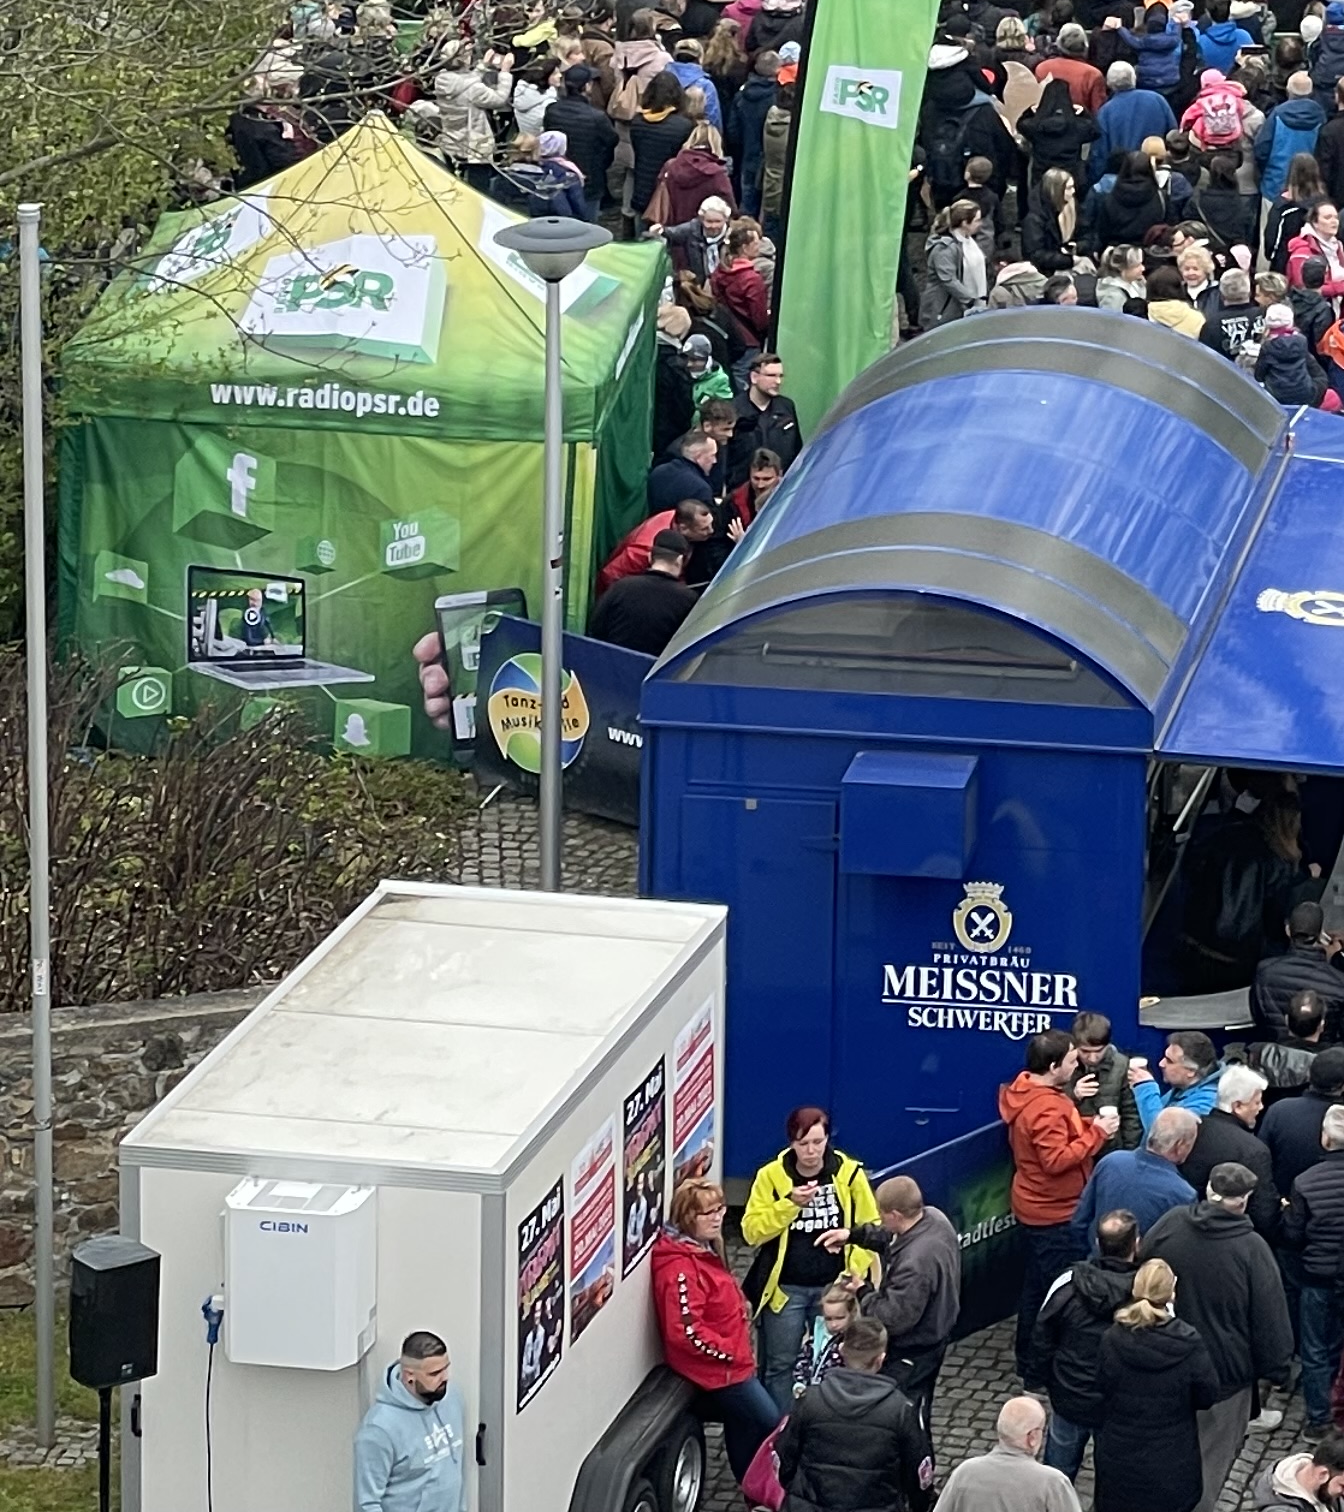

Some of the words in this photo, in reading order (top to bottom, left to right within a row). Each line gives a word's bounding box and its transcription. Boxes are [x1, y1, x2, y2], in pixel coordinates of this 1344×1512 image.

[839, 79, 889, 114] PSR
[291, 265, 393, 312] PSR
[210, 382, 440, 418] www.radiopsr.de
[393, 521, 419, 540] You
[389, 543, 421, 562] Tube
[933, 953, 1031, 968] PRIVATBRÄU
[882, 964, 1078, 1007] MEISSNER
[908, 1006, 1052, 1041] SCHWERTER
[260, 1220, 308, 1233] CIBIN
[521, 1215, 540, 1251] 27.
[542, 1186, 561, 1223] Mai
[957, 1212, 1017, 1250] adtfest
